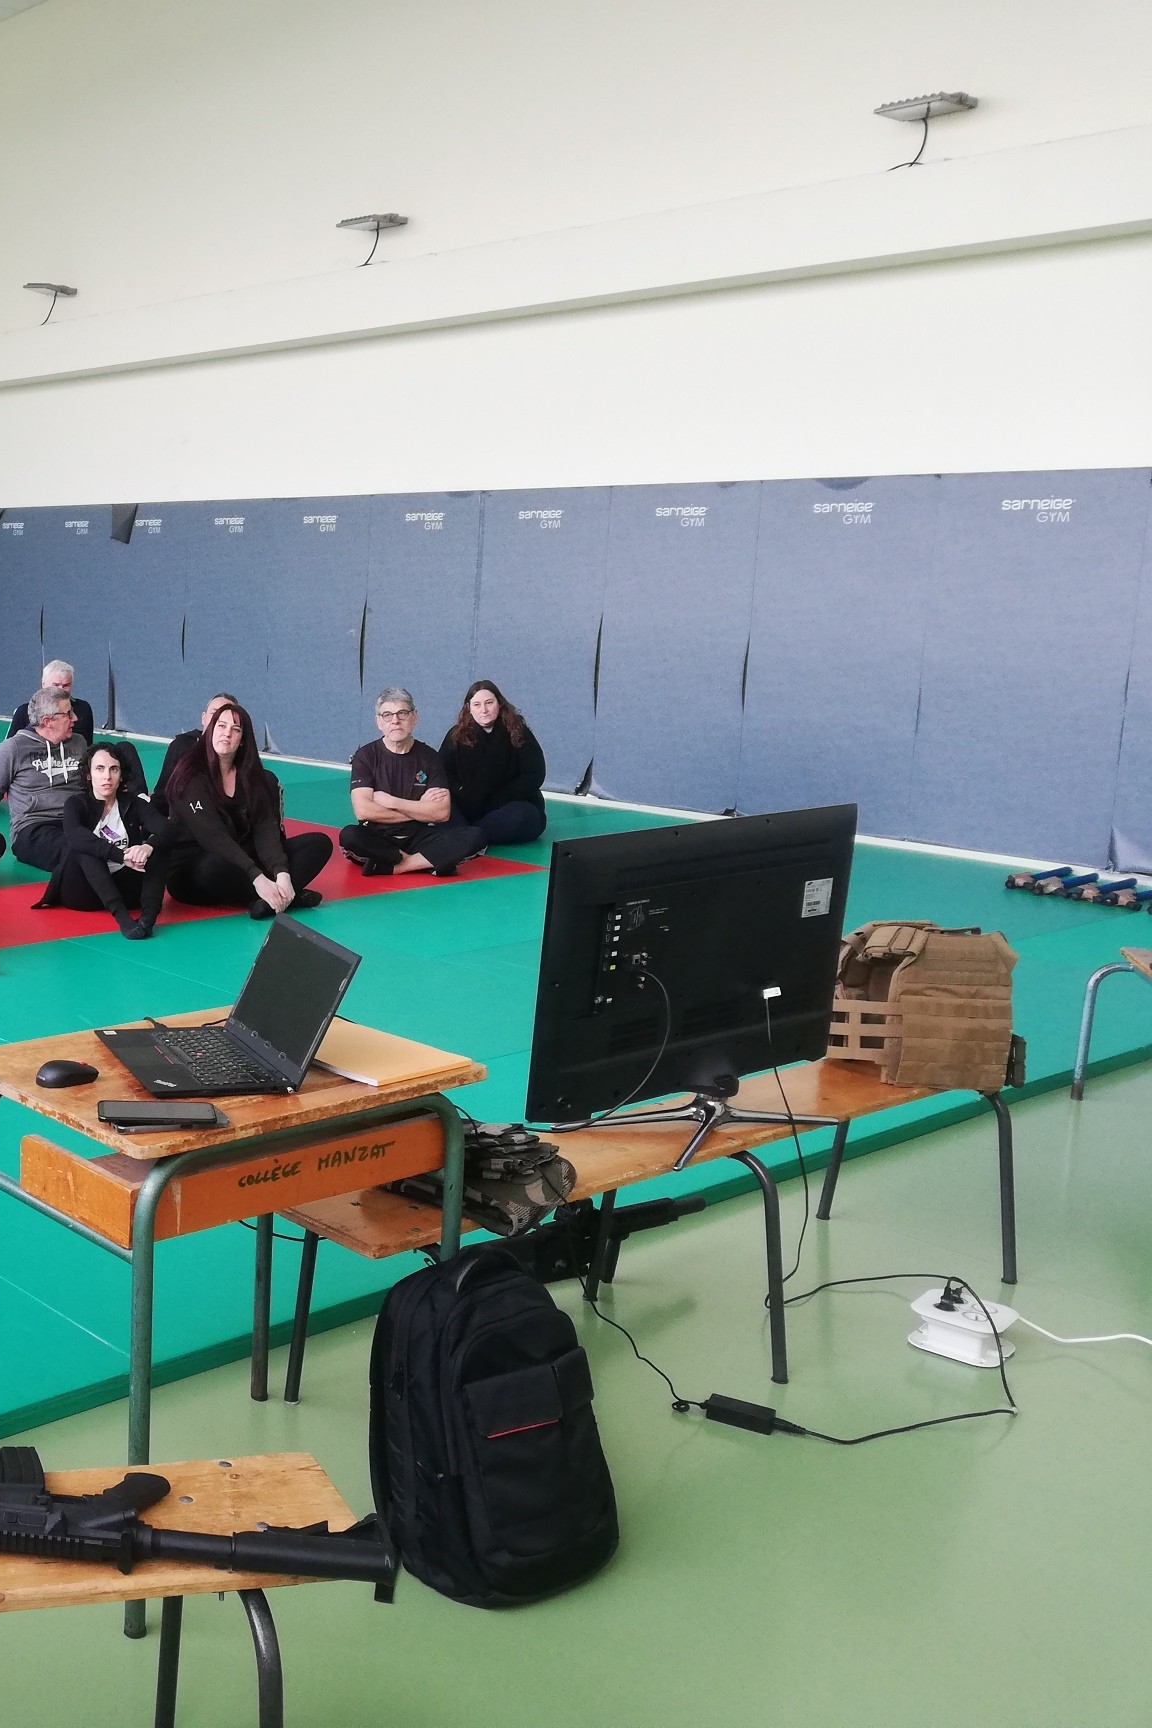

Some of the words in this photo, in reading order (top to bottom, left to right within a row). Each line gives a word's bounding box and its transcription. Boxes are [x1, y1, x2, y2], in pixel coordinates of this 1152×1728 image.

[680, 517, 705, 527] GYM
[843, 514, 871, 524] GYM
[1037, 512, 1069, 522] GYM
[423, 521, 443, 531] GYM
[539, 519, 561, 529] GYM
[237, 1158, 302, 1187] COLLÈGE
[317, 1140, 396, 1171] MANZAT
